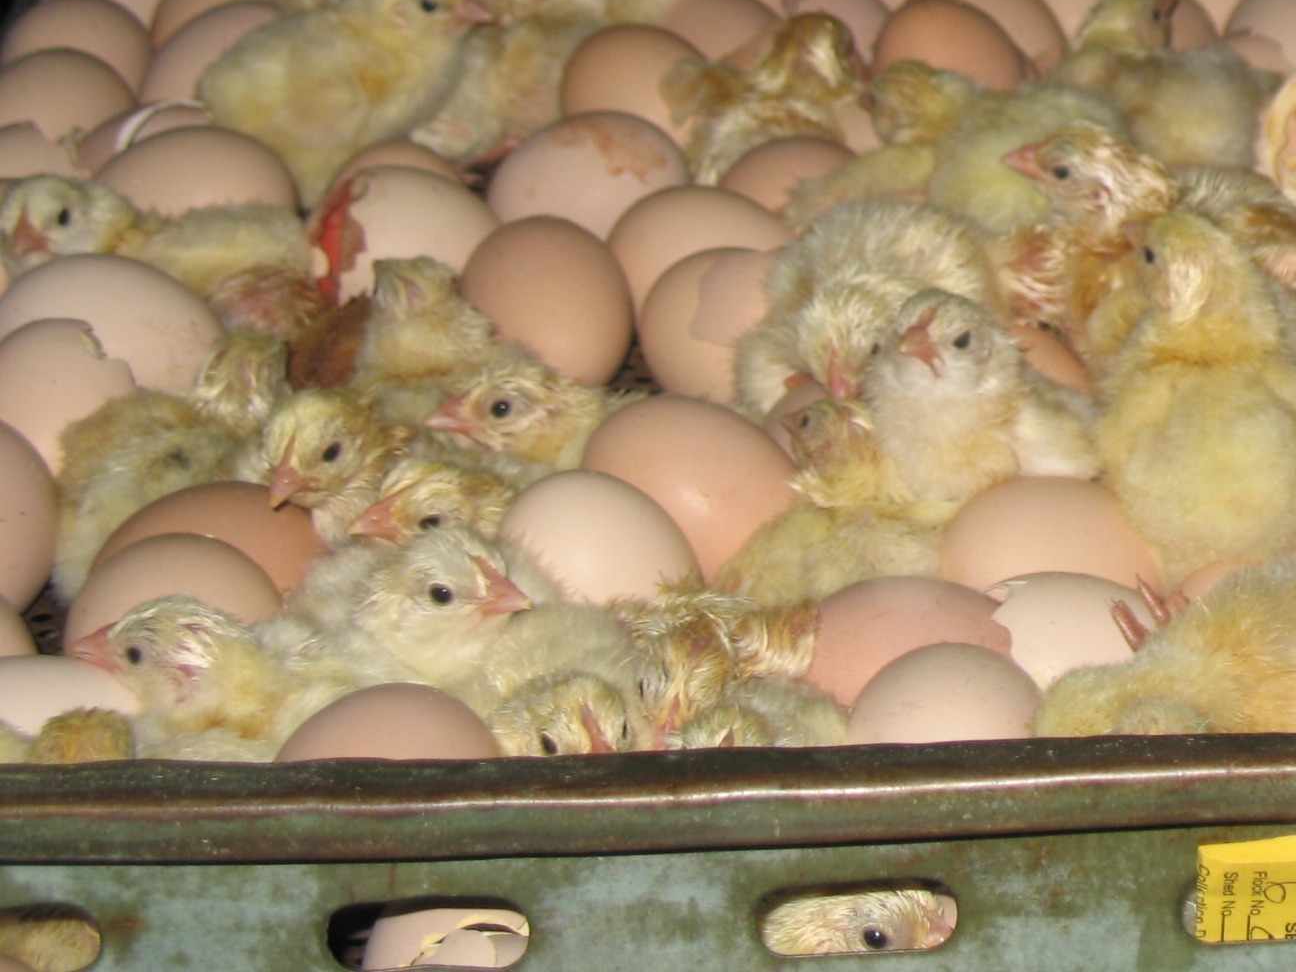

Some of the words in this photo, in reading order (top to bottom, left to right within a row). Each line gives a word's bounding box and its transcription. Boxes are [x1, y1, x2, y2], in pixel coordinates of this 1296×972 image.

[1222, 872, 1239, 897] Shed
[1252, 871, 1268, 897] Flock
[1221, 901, 1236, 917] No
[1250, 900, 1265, 916] No
